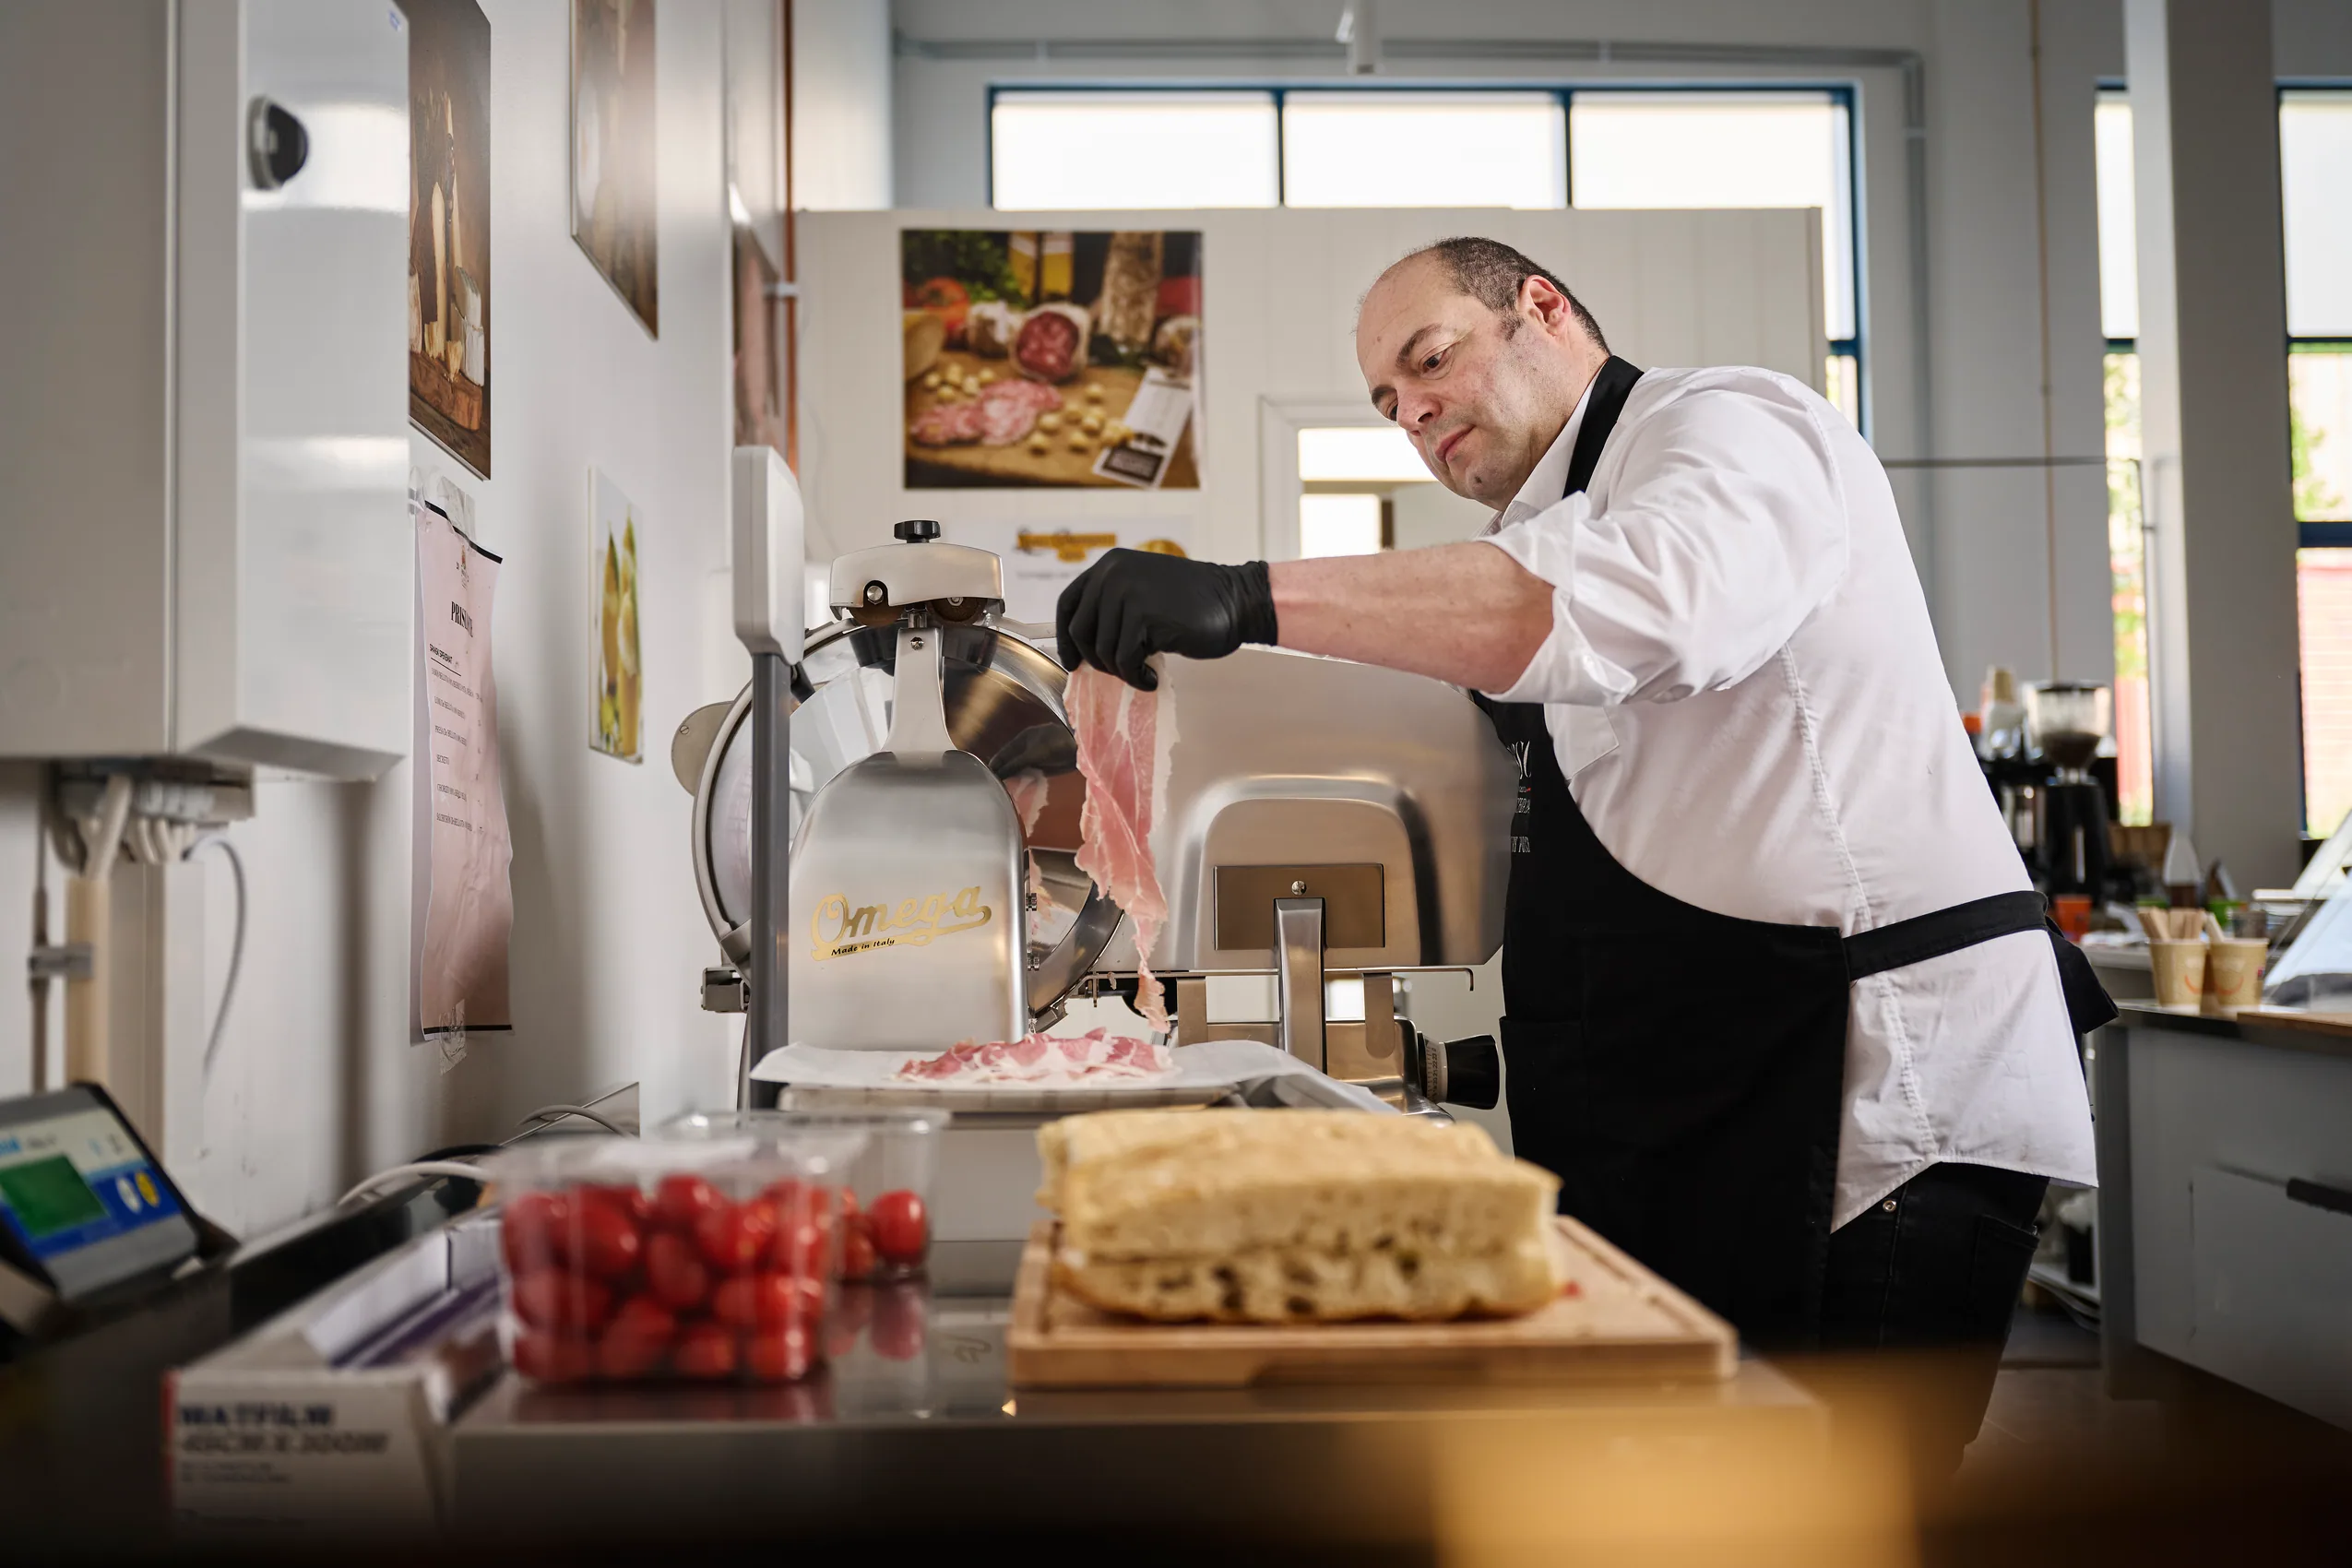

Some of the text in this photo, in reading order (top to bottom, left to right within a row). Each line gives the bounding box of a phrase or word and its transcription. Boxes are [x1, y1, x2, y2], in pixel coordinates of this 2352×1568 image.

[811, 886, 992, 952] Omega
[831, 937, 896, 956] Made in Italy
